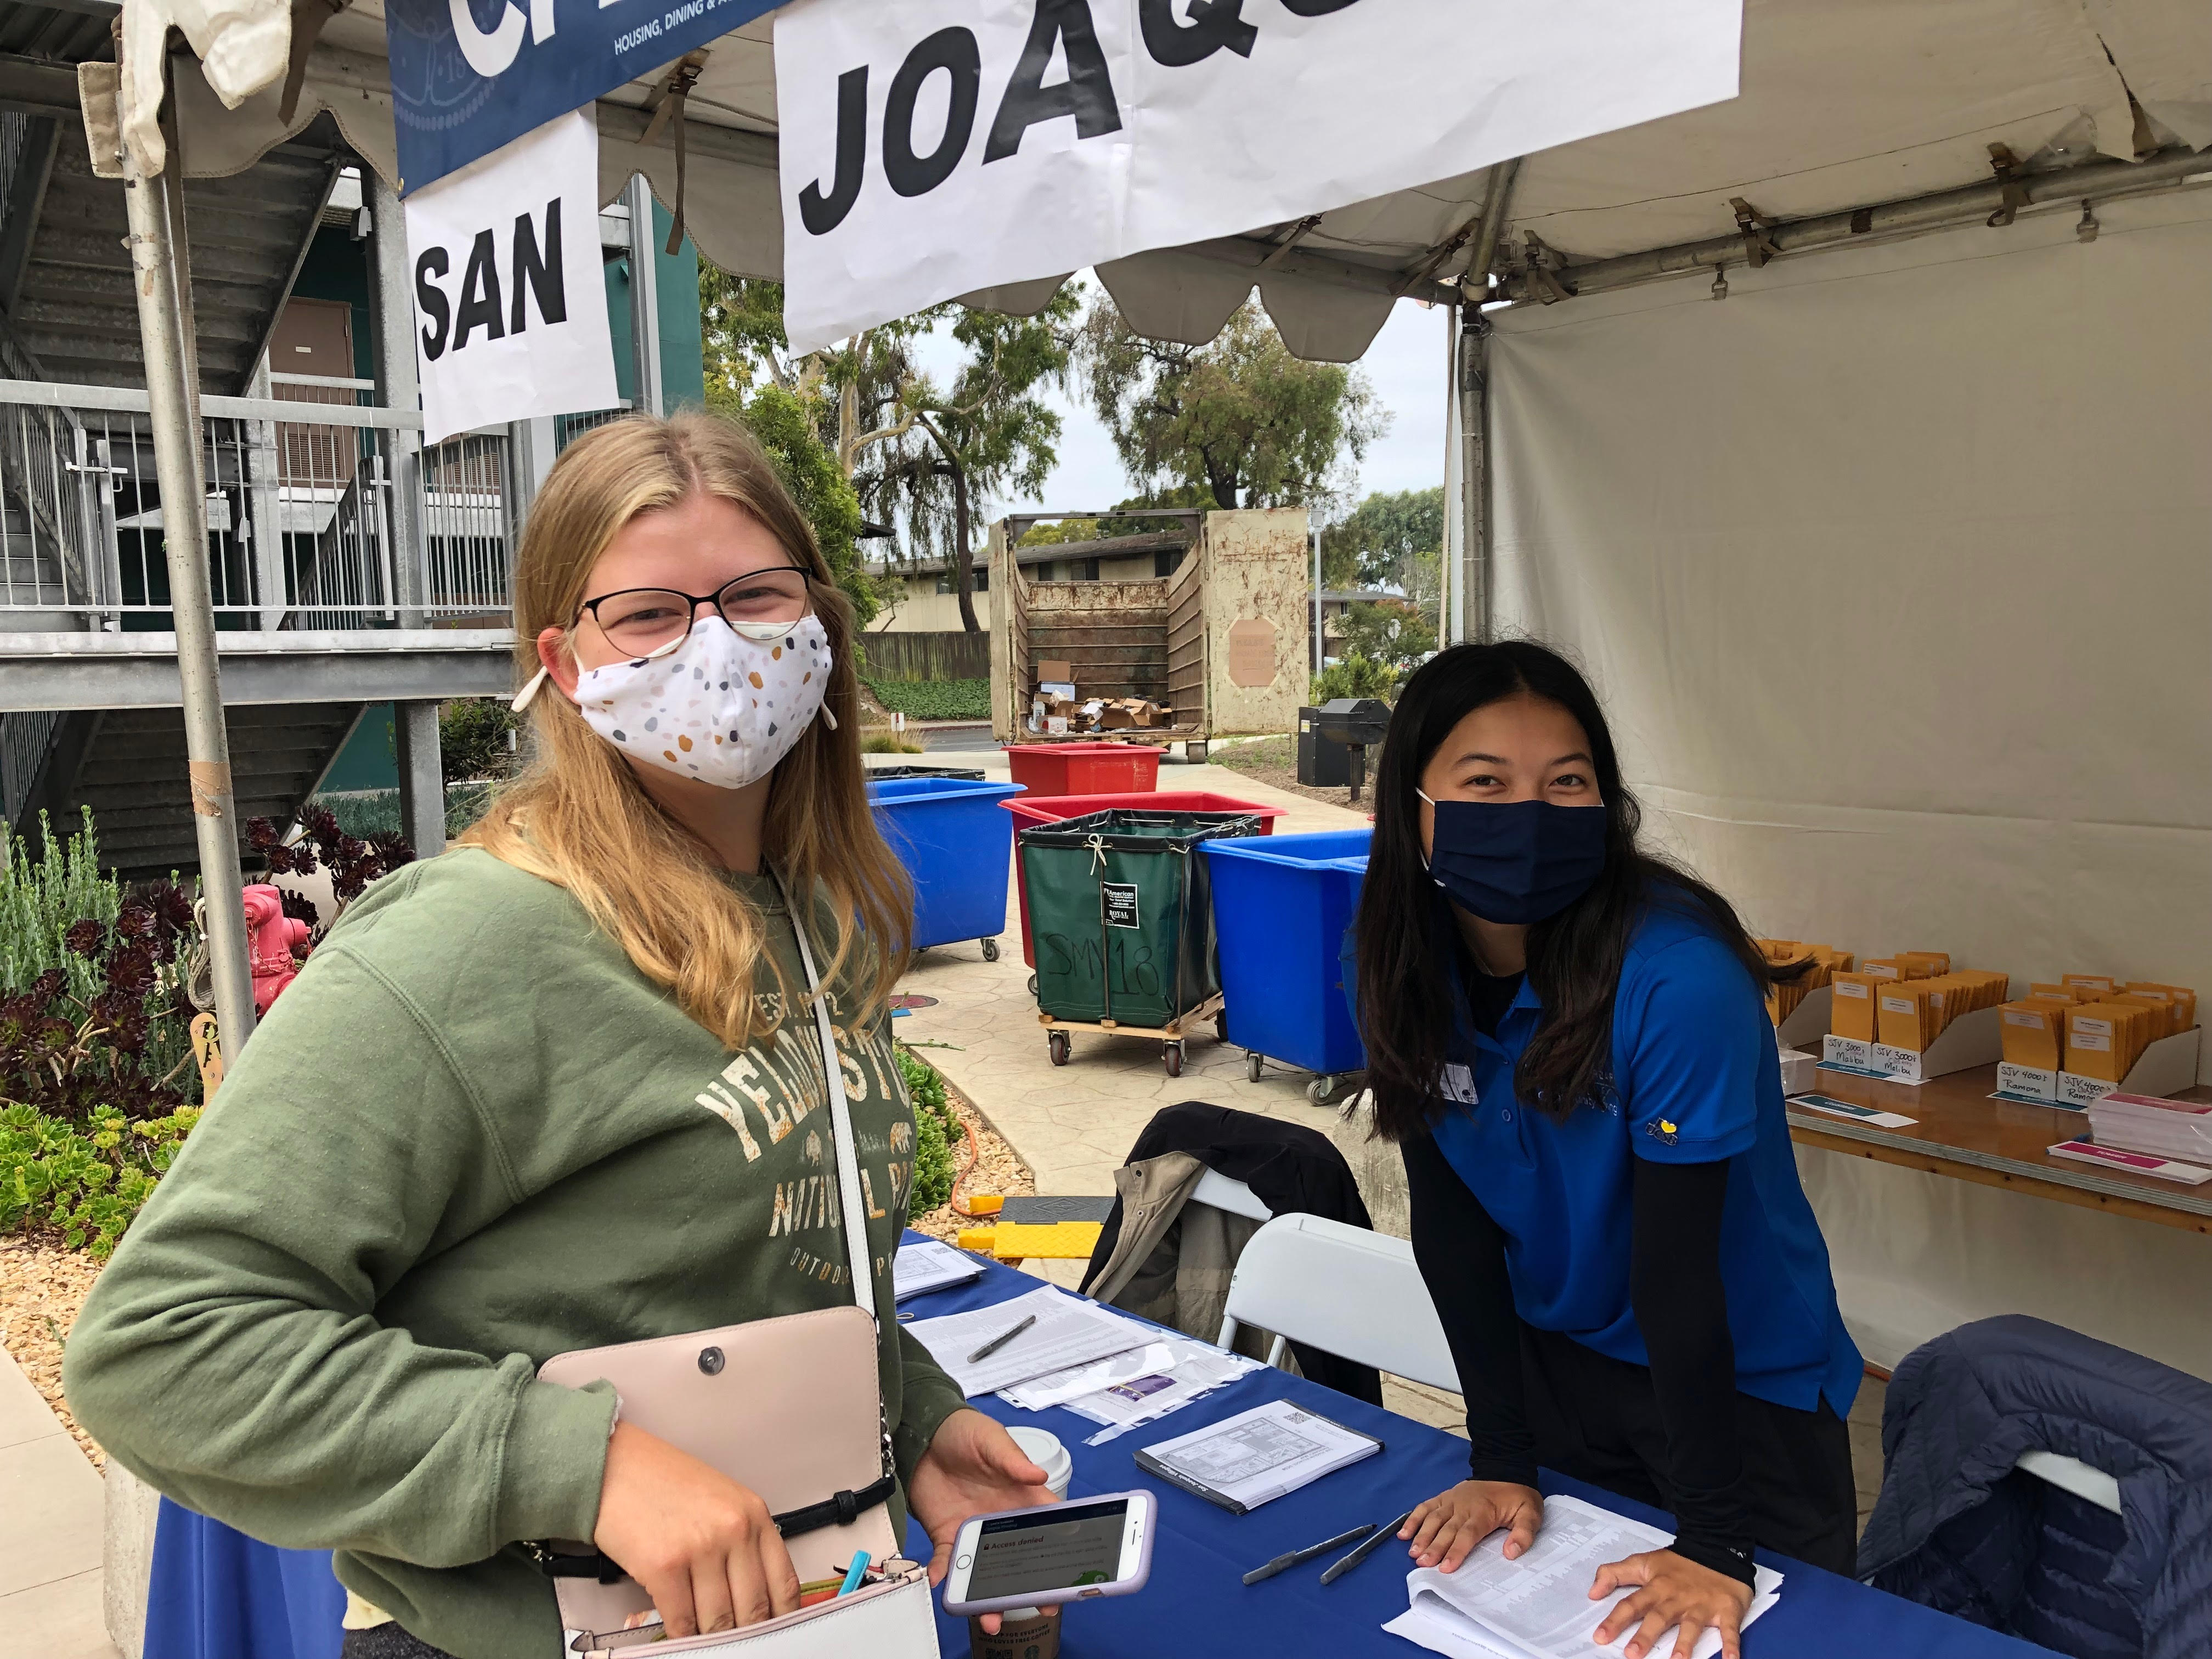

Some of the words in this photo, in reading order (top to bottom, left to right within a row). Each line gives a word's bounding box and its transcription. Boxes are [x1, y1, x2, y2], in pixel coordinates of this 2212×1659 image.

[614, 19, 663, 55] HOUSING,
[665, 0, 703, 30] DINING
[415, 197, 567, 362] SAN
[1109, 910, 1128, 919] ROYAL
[1828, 1039, 1842, 1047] SJV
[1836, 1052, 1865, 1064] Malibu
[1877, 1047, 1892, 1057] SJV
[1884, 1062, 1911, 1075] Malibu
[2001, 1066, 2019, 1076] SJV
[2002, 1079, 2041, 1094] Ramona
[2064, 1076, 2083, 1087] SJV
[1159, 1464, 1178, 1476] Villages
[1178, 1475, 1198, 1486] Joaquin
[991, 1541, 1015, 1550] Access
[1018, 1536, 1045, 1546] denied
[978, 1635, 993, 1644] WHO
[1031, 1628, 1050, 1640] COFFEE
[1020, 1623, 1048, 1637] EVERYONE
